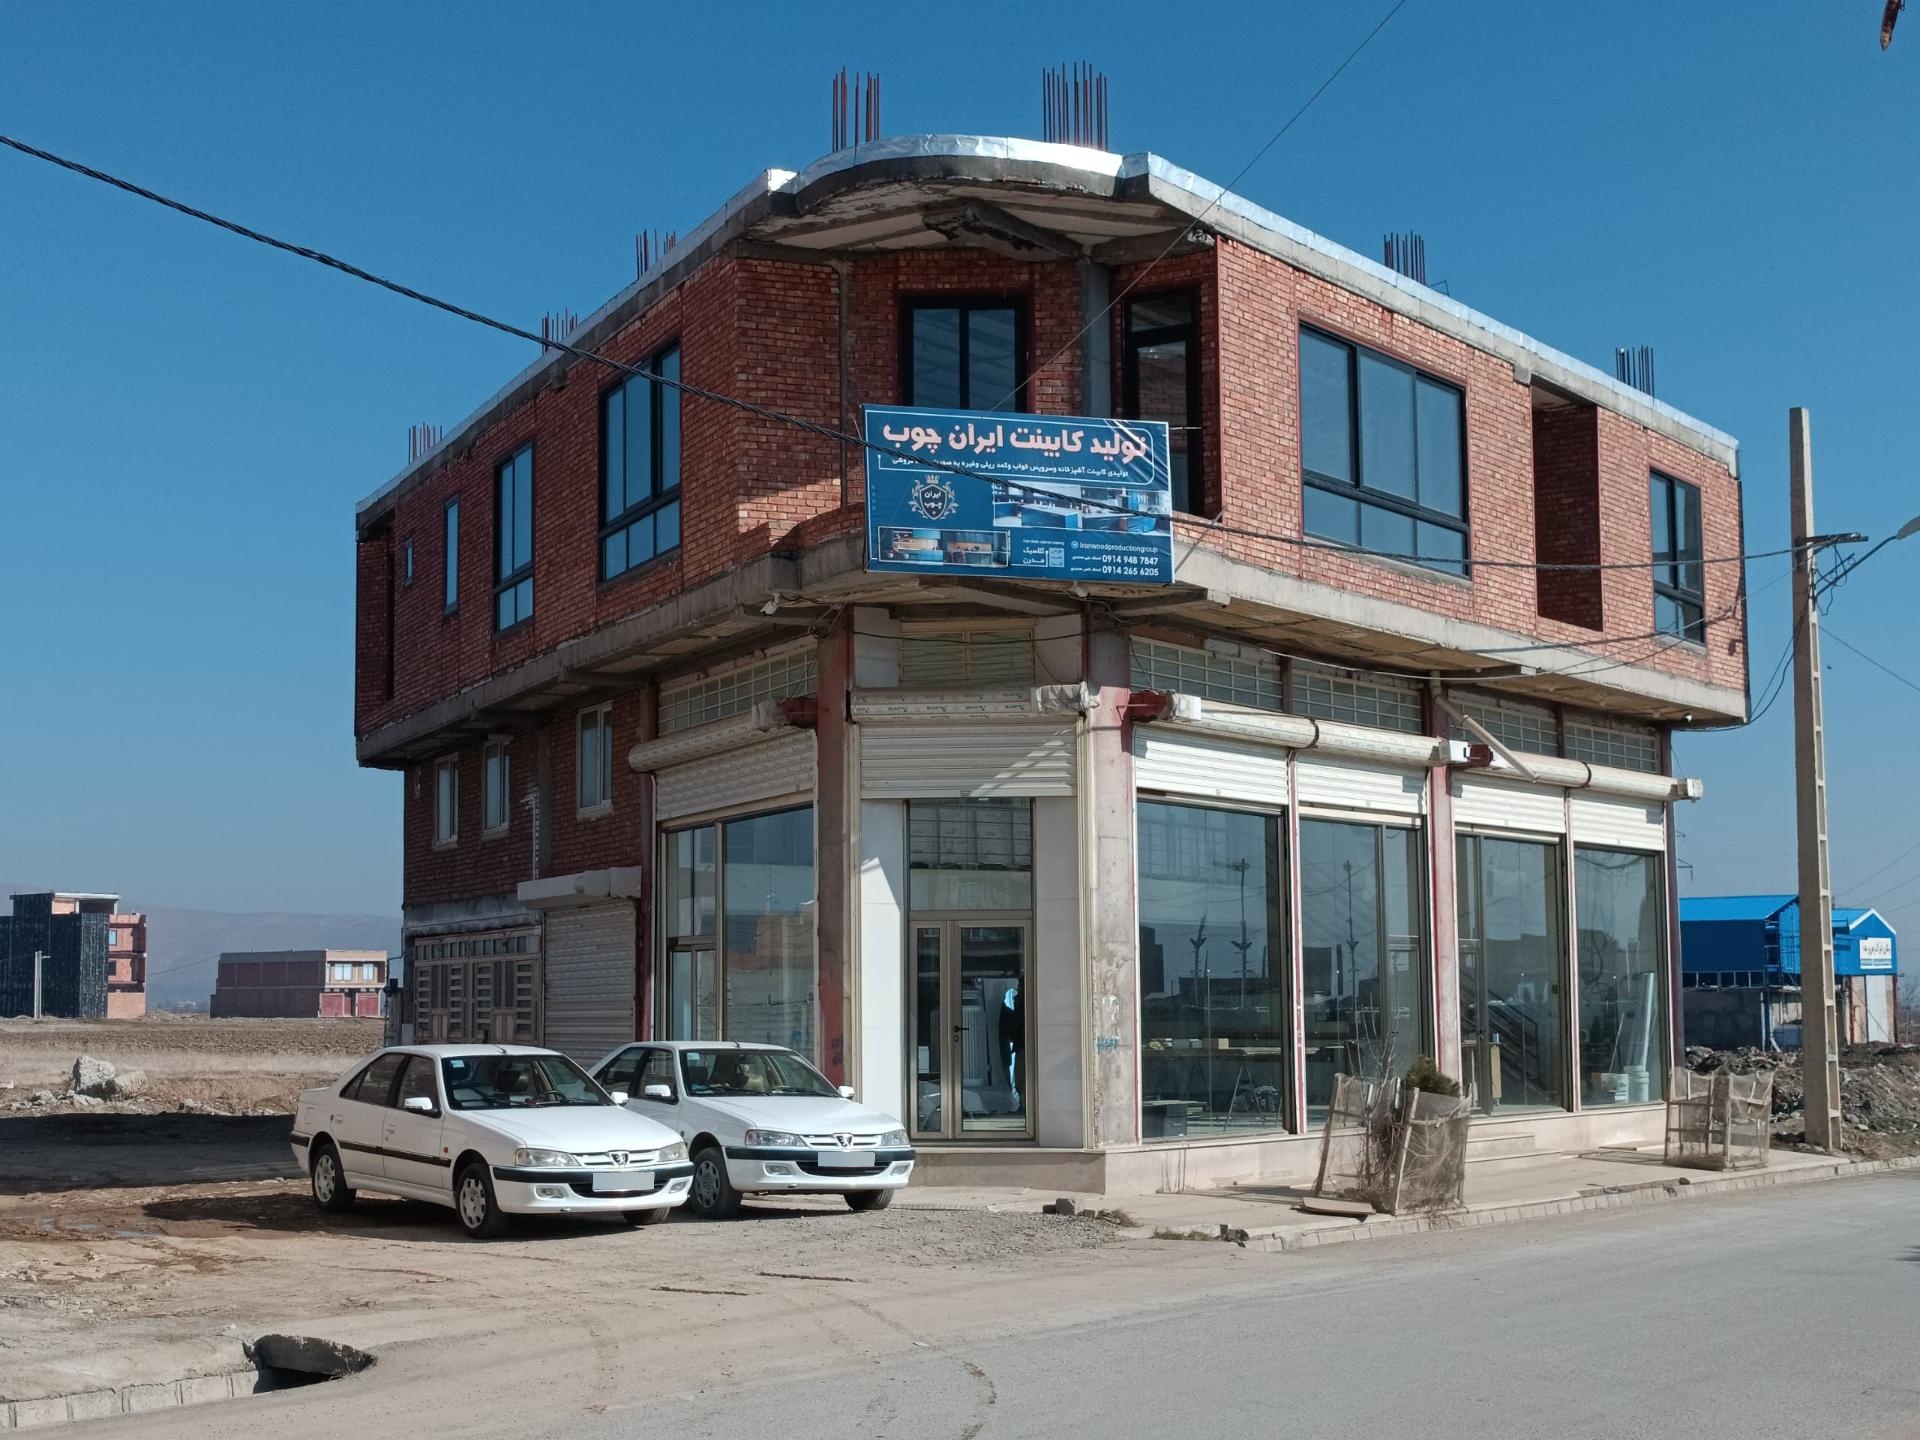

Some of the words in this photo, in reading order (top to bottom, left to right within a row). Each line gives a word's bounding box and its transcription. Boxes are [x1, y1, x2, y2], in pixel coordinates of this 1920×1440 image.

[882, 424, 942, 453] چوب
[948, 423, 1004, 455] ایران
[1009, 427, 1084, 458] کابینت
[1089, 431, 1148, 464] تولید
[1058, 466, 1086, 476] آشپزخانه
[1086, 467, 1107, 476] کابینت
[924, 490, 942, 499] ایران
[1022, 547, 1045, 555] کلاسیک
[1022, 557, 1045, 565] مدرن
[1101, 554, 1122, 564] 0914
[1123, 555, 1138, 564] 948
[1139, 556, 1159, 566] 7847
[1102, 565, 1122, 574] 0914
[1123, 566, 1138, 576] 265
[1139, 567, 1159, 576] 6205
